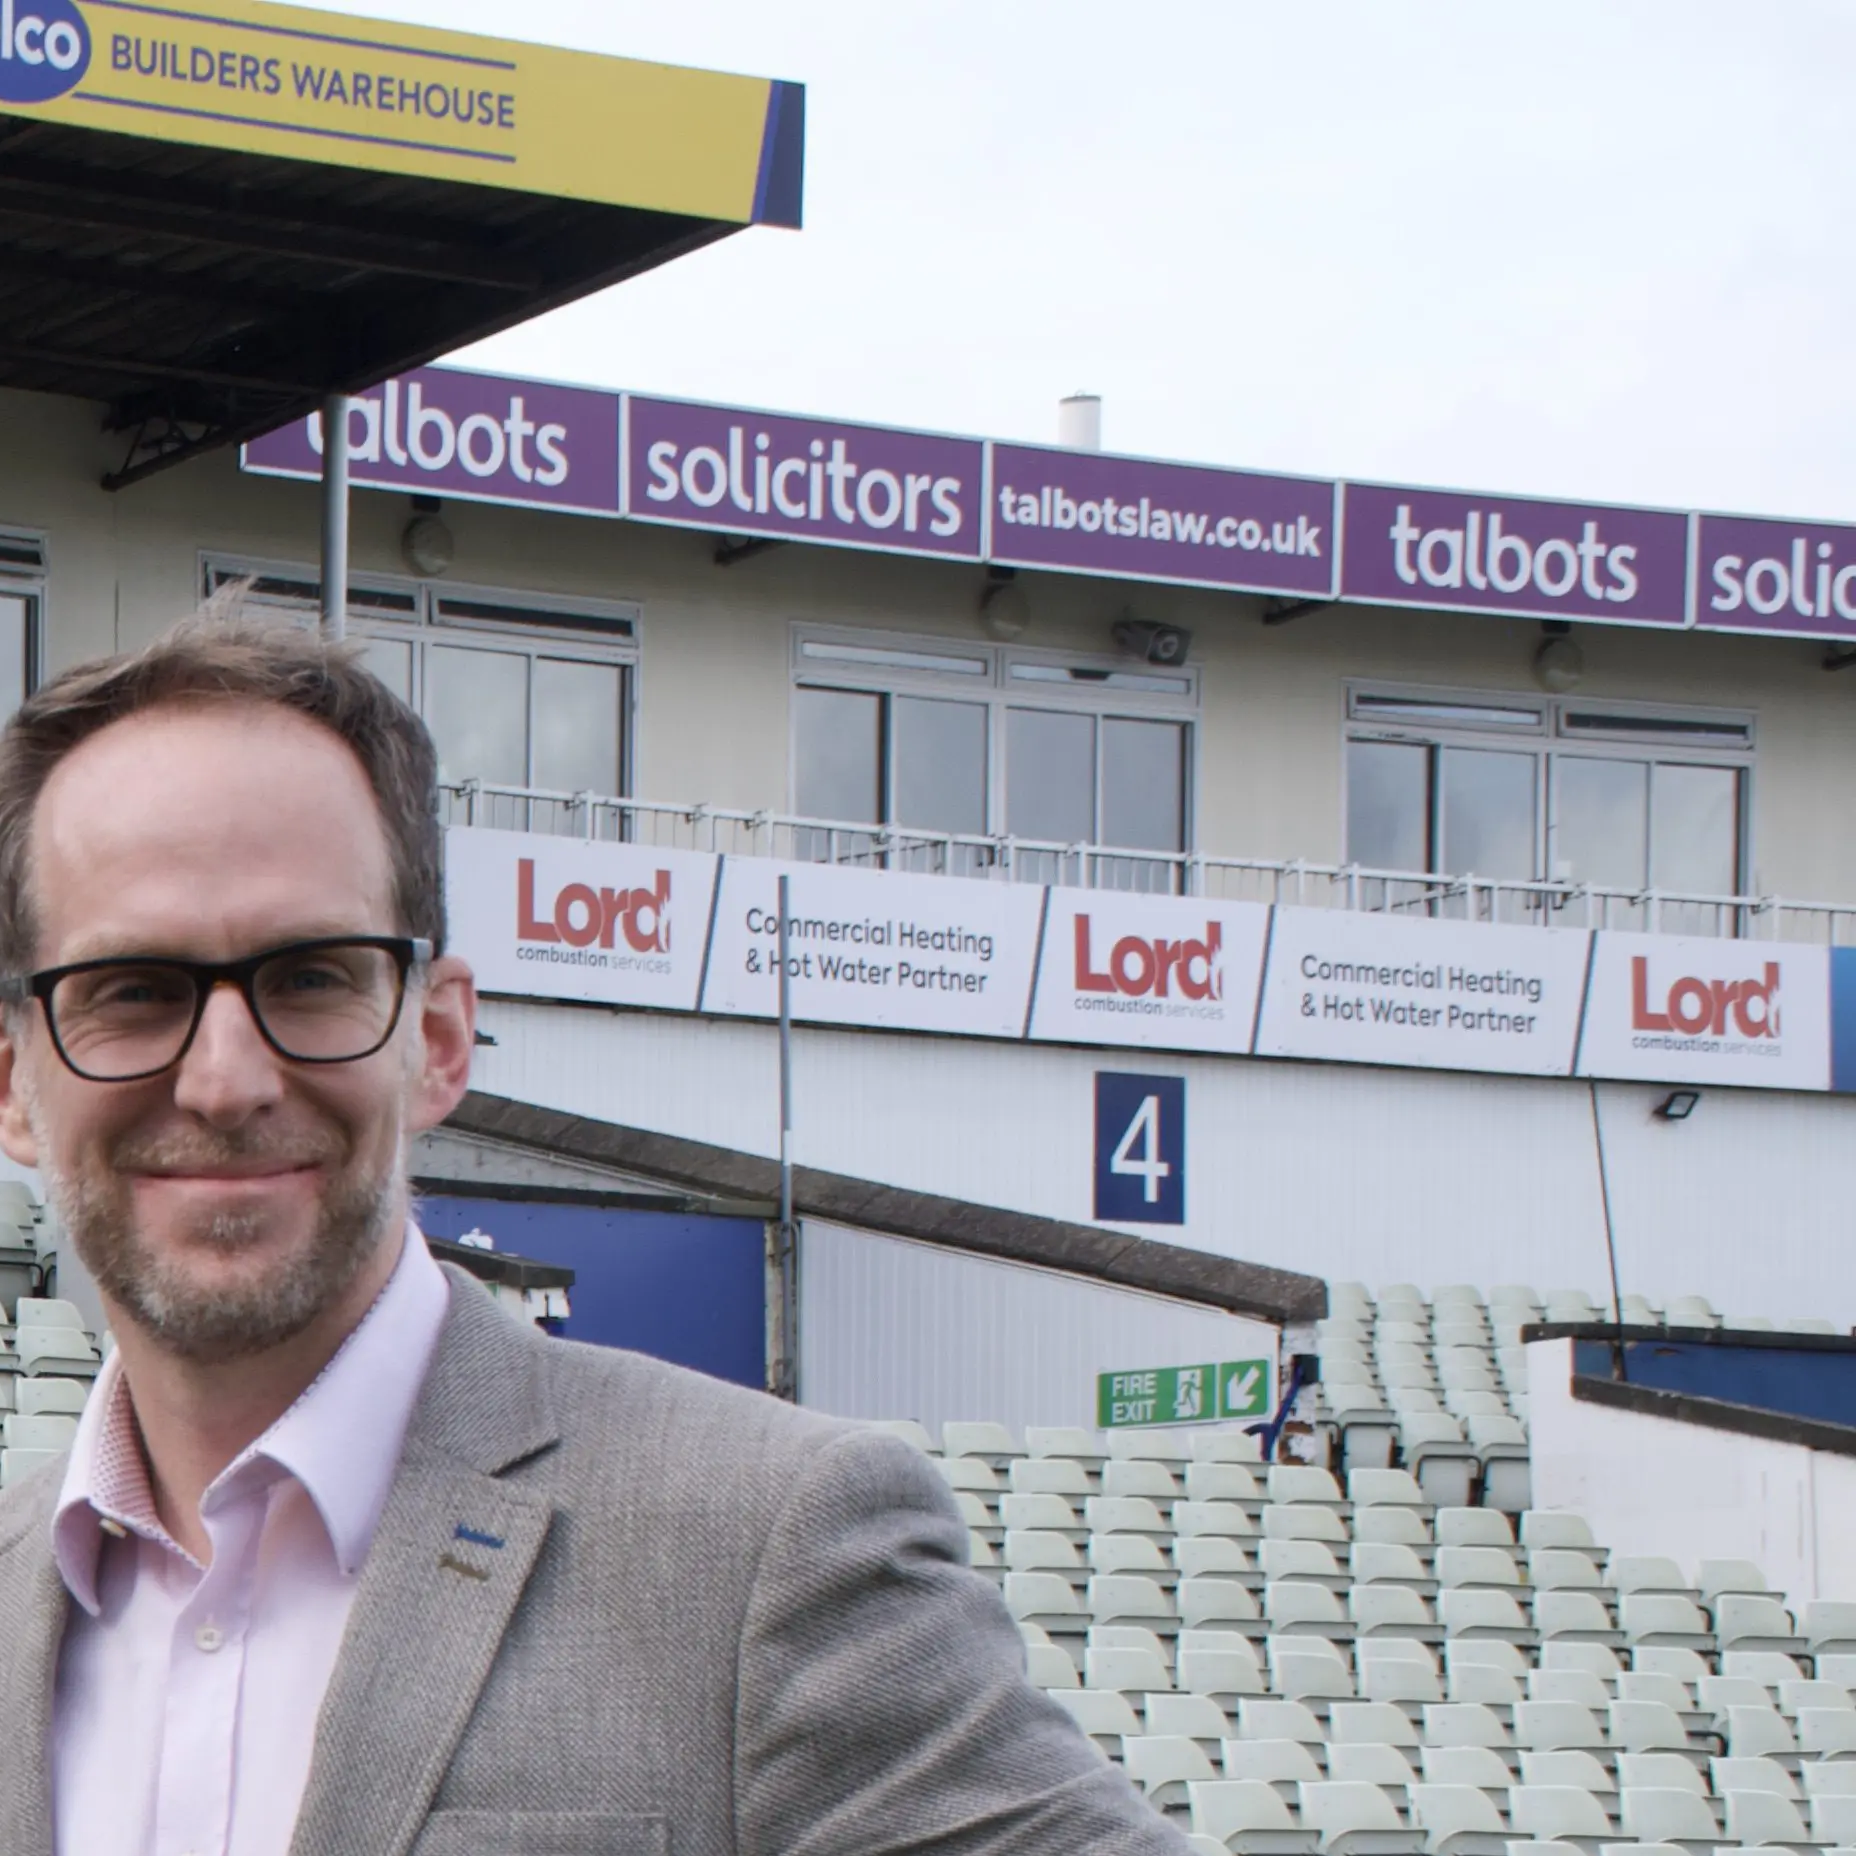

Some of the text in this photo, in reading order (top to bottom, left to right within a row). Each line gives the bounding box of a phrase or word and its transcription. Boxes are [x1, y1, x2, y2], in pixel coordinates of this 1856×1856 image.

[111, 33, 281, 96] BUILDERS
[292, 62, 516, 129] WAREHOUSE
[646, 426, 962, 538] solicitors
[999, 485, 1322, 557] talbotslaw.co.uk
[1390, 504, 1638, 602] talbots
[1711, 537, 1856, 620] solic
[517, 858, 671, 953] Lord
[898, 921, 994, 962] Heating
[516, 946, 673, 975] combustion services
[745, 948, 762, 974] &
[817, 953, 892, 986] Water
[898, 961, 988, 993] Partner
[1074, 913, 1222, 1001] Lord
[1300, 954, 1543, 1003] Commercial Heating
[1074, 996, 1163, 1016] combustion
[1300, 992, 1536, 1034] & Hot Water Partner
[1632, 956, 1779, 1038] Lord
[1109, 1096, 1170, 1203] 4
[1112, 1372, 1158, 1398] FIRE
[1112, 1399, 1157, 1424] EXIT
